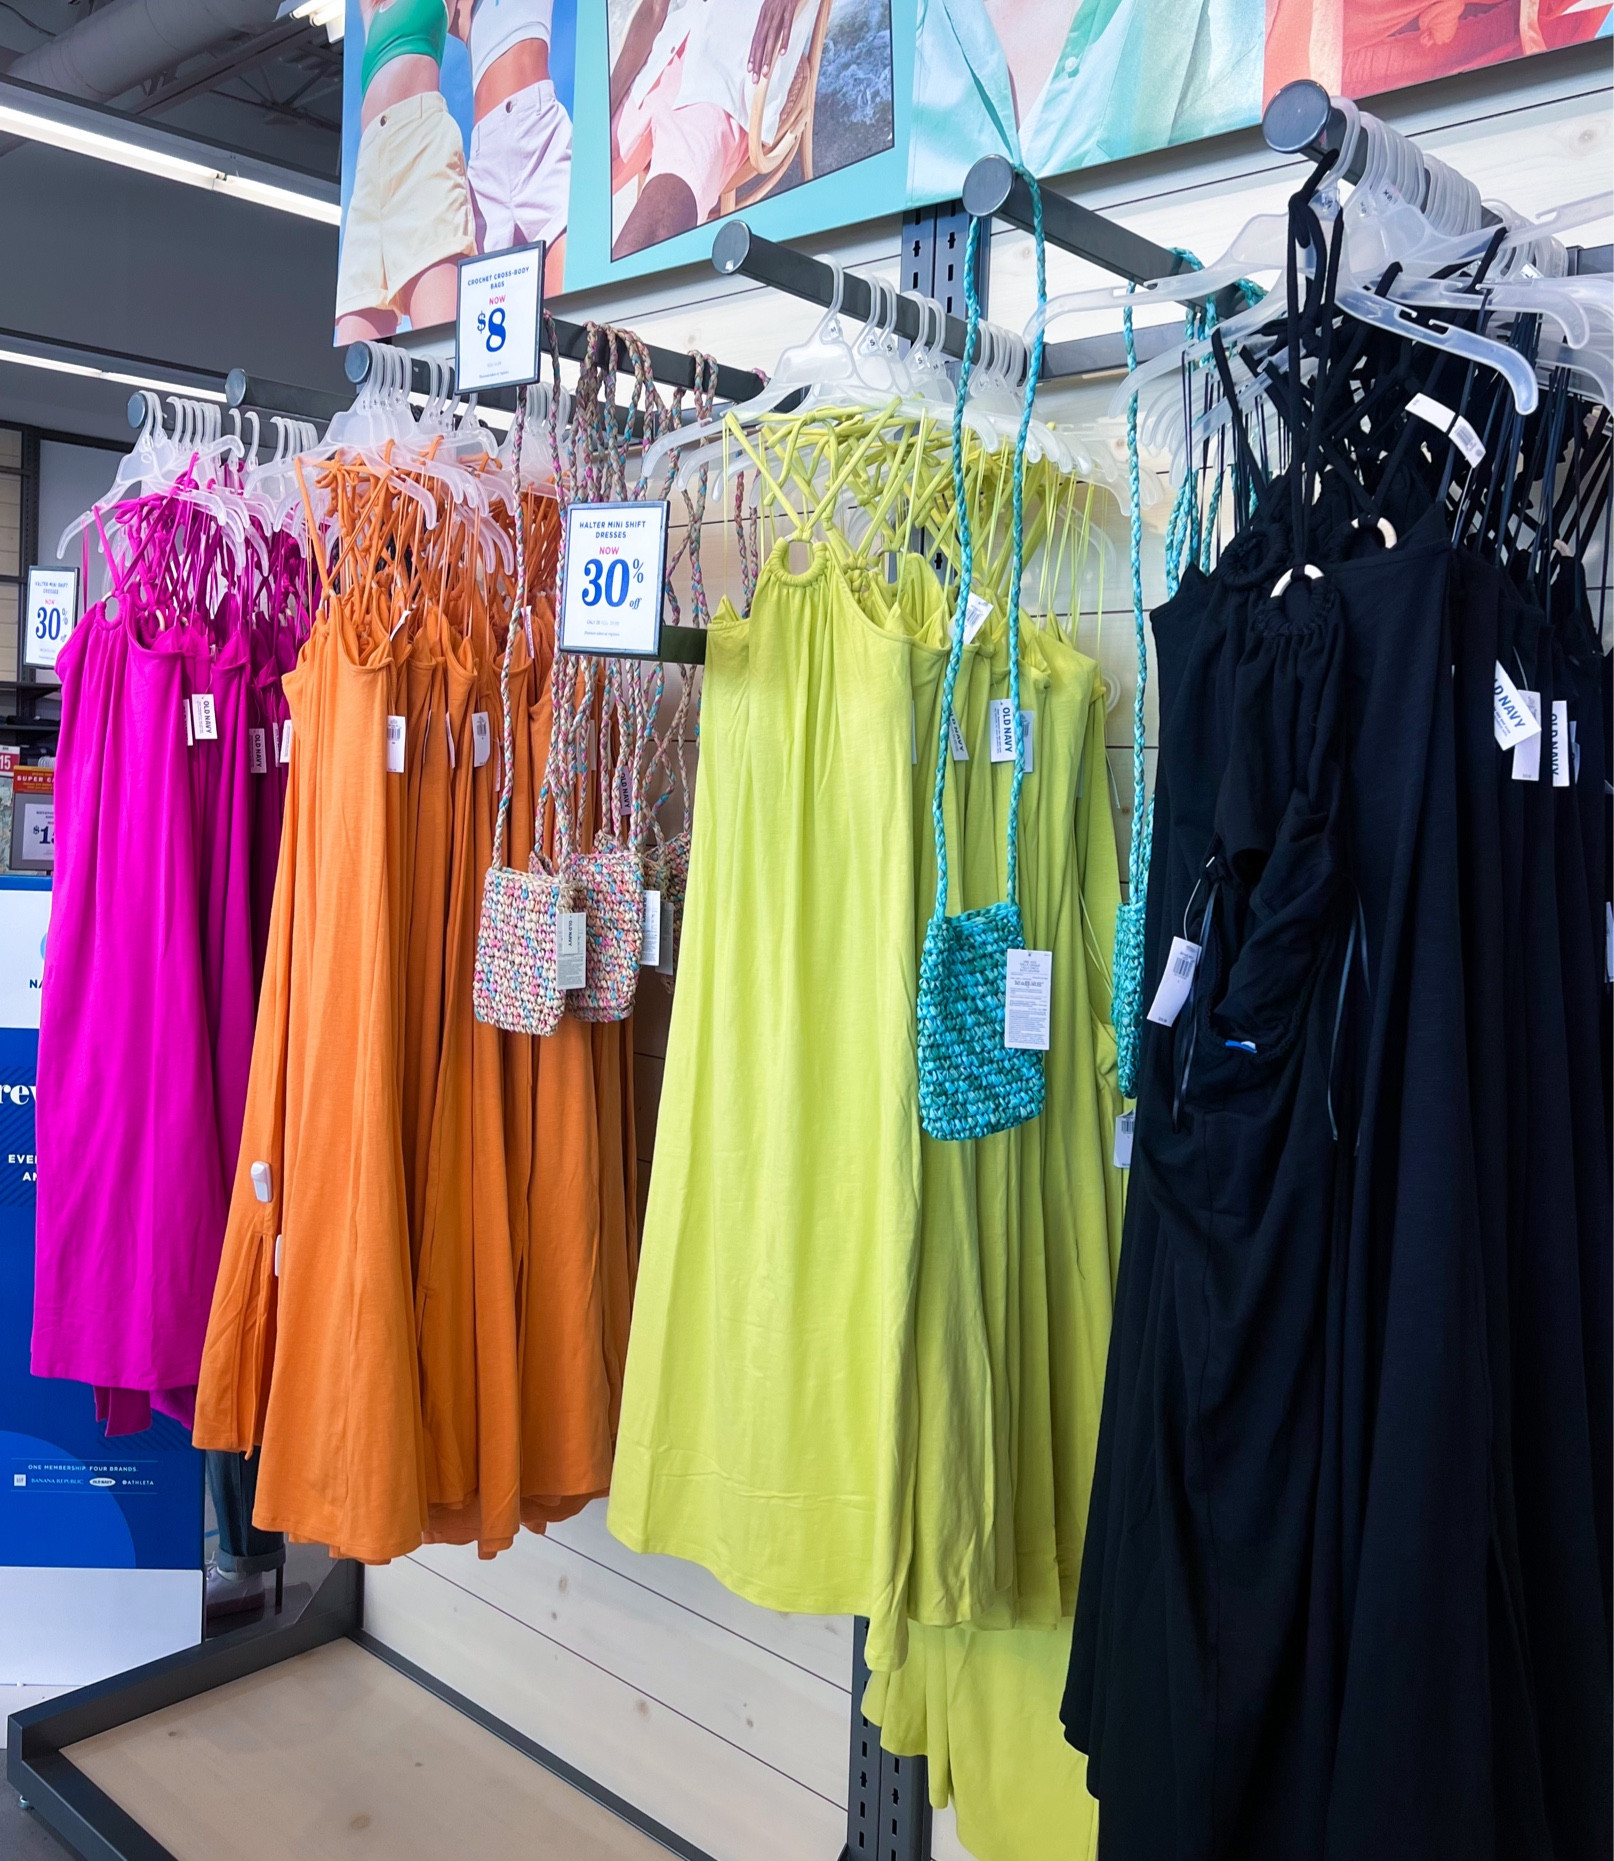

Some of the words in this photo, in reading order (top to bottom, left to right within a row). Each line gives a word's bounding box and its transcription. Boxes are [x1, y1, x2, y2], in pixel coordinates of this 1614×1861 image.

[467, 275, 492, 286] CROCHET
[493, 267, 530, 280] CROSS-BODY
[490, 281, 505, 290] BAGS
[488, 295, 506, 305] NOW
[579, 521, 606, 529] HALTER
[607, 521, 623, 529] MINI
[625, 520, 646, 529] SHIFT
[595, 531, 627, 539] DRESSES
[599, 546, 620, 555] NOW
[629, 597, 642, 610] off
[1002, 707, 1012, 726] OLD
[1498, 695, 1526, 728] NAVY
[204, 715, 212, 734] NAVY
[254, 734, 262, 748] OLD
[954, 726, 965, 752] NAVY
[1003, 727, 1013, 753] NAVY
[17, 775, 44, 783] SUPER
[622, 788, 631, 808] NAVY
